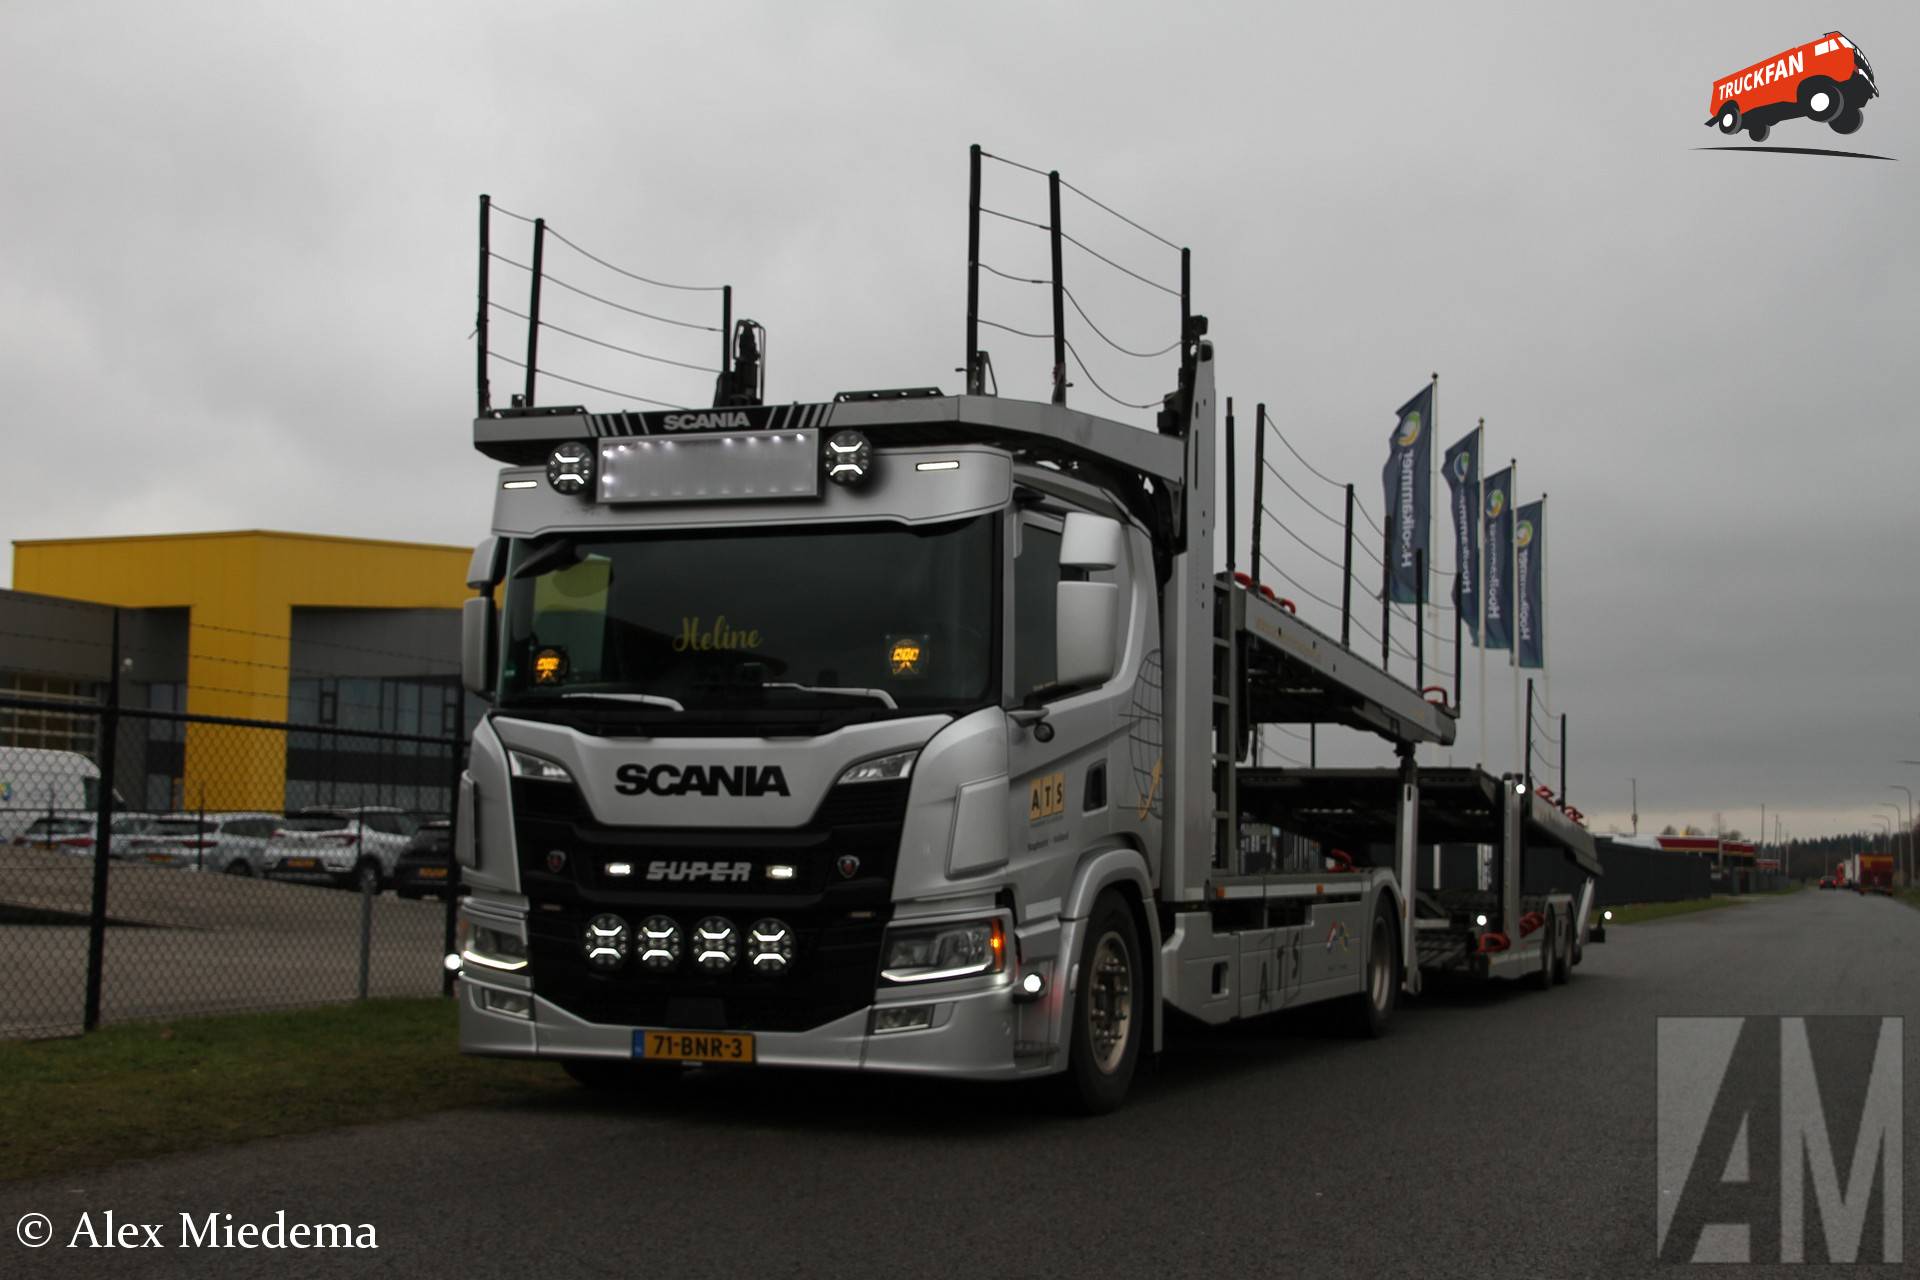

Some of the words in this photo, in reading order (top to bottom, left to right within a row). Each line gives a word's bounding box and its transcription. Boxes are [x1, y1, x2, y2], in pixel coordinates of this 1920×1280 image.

[663, 411, 751, 431] SCANIA
[614, 763, 792, 798] SCANIA
[646, 860, 752, 882] SUPER
[653, 1034, 743, 1058] 71-BNR-3
